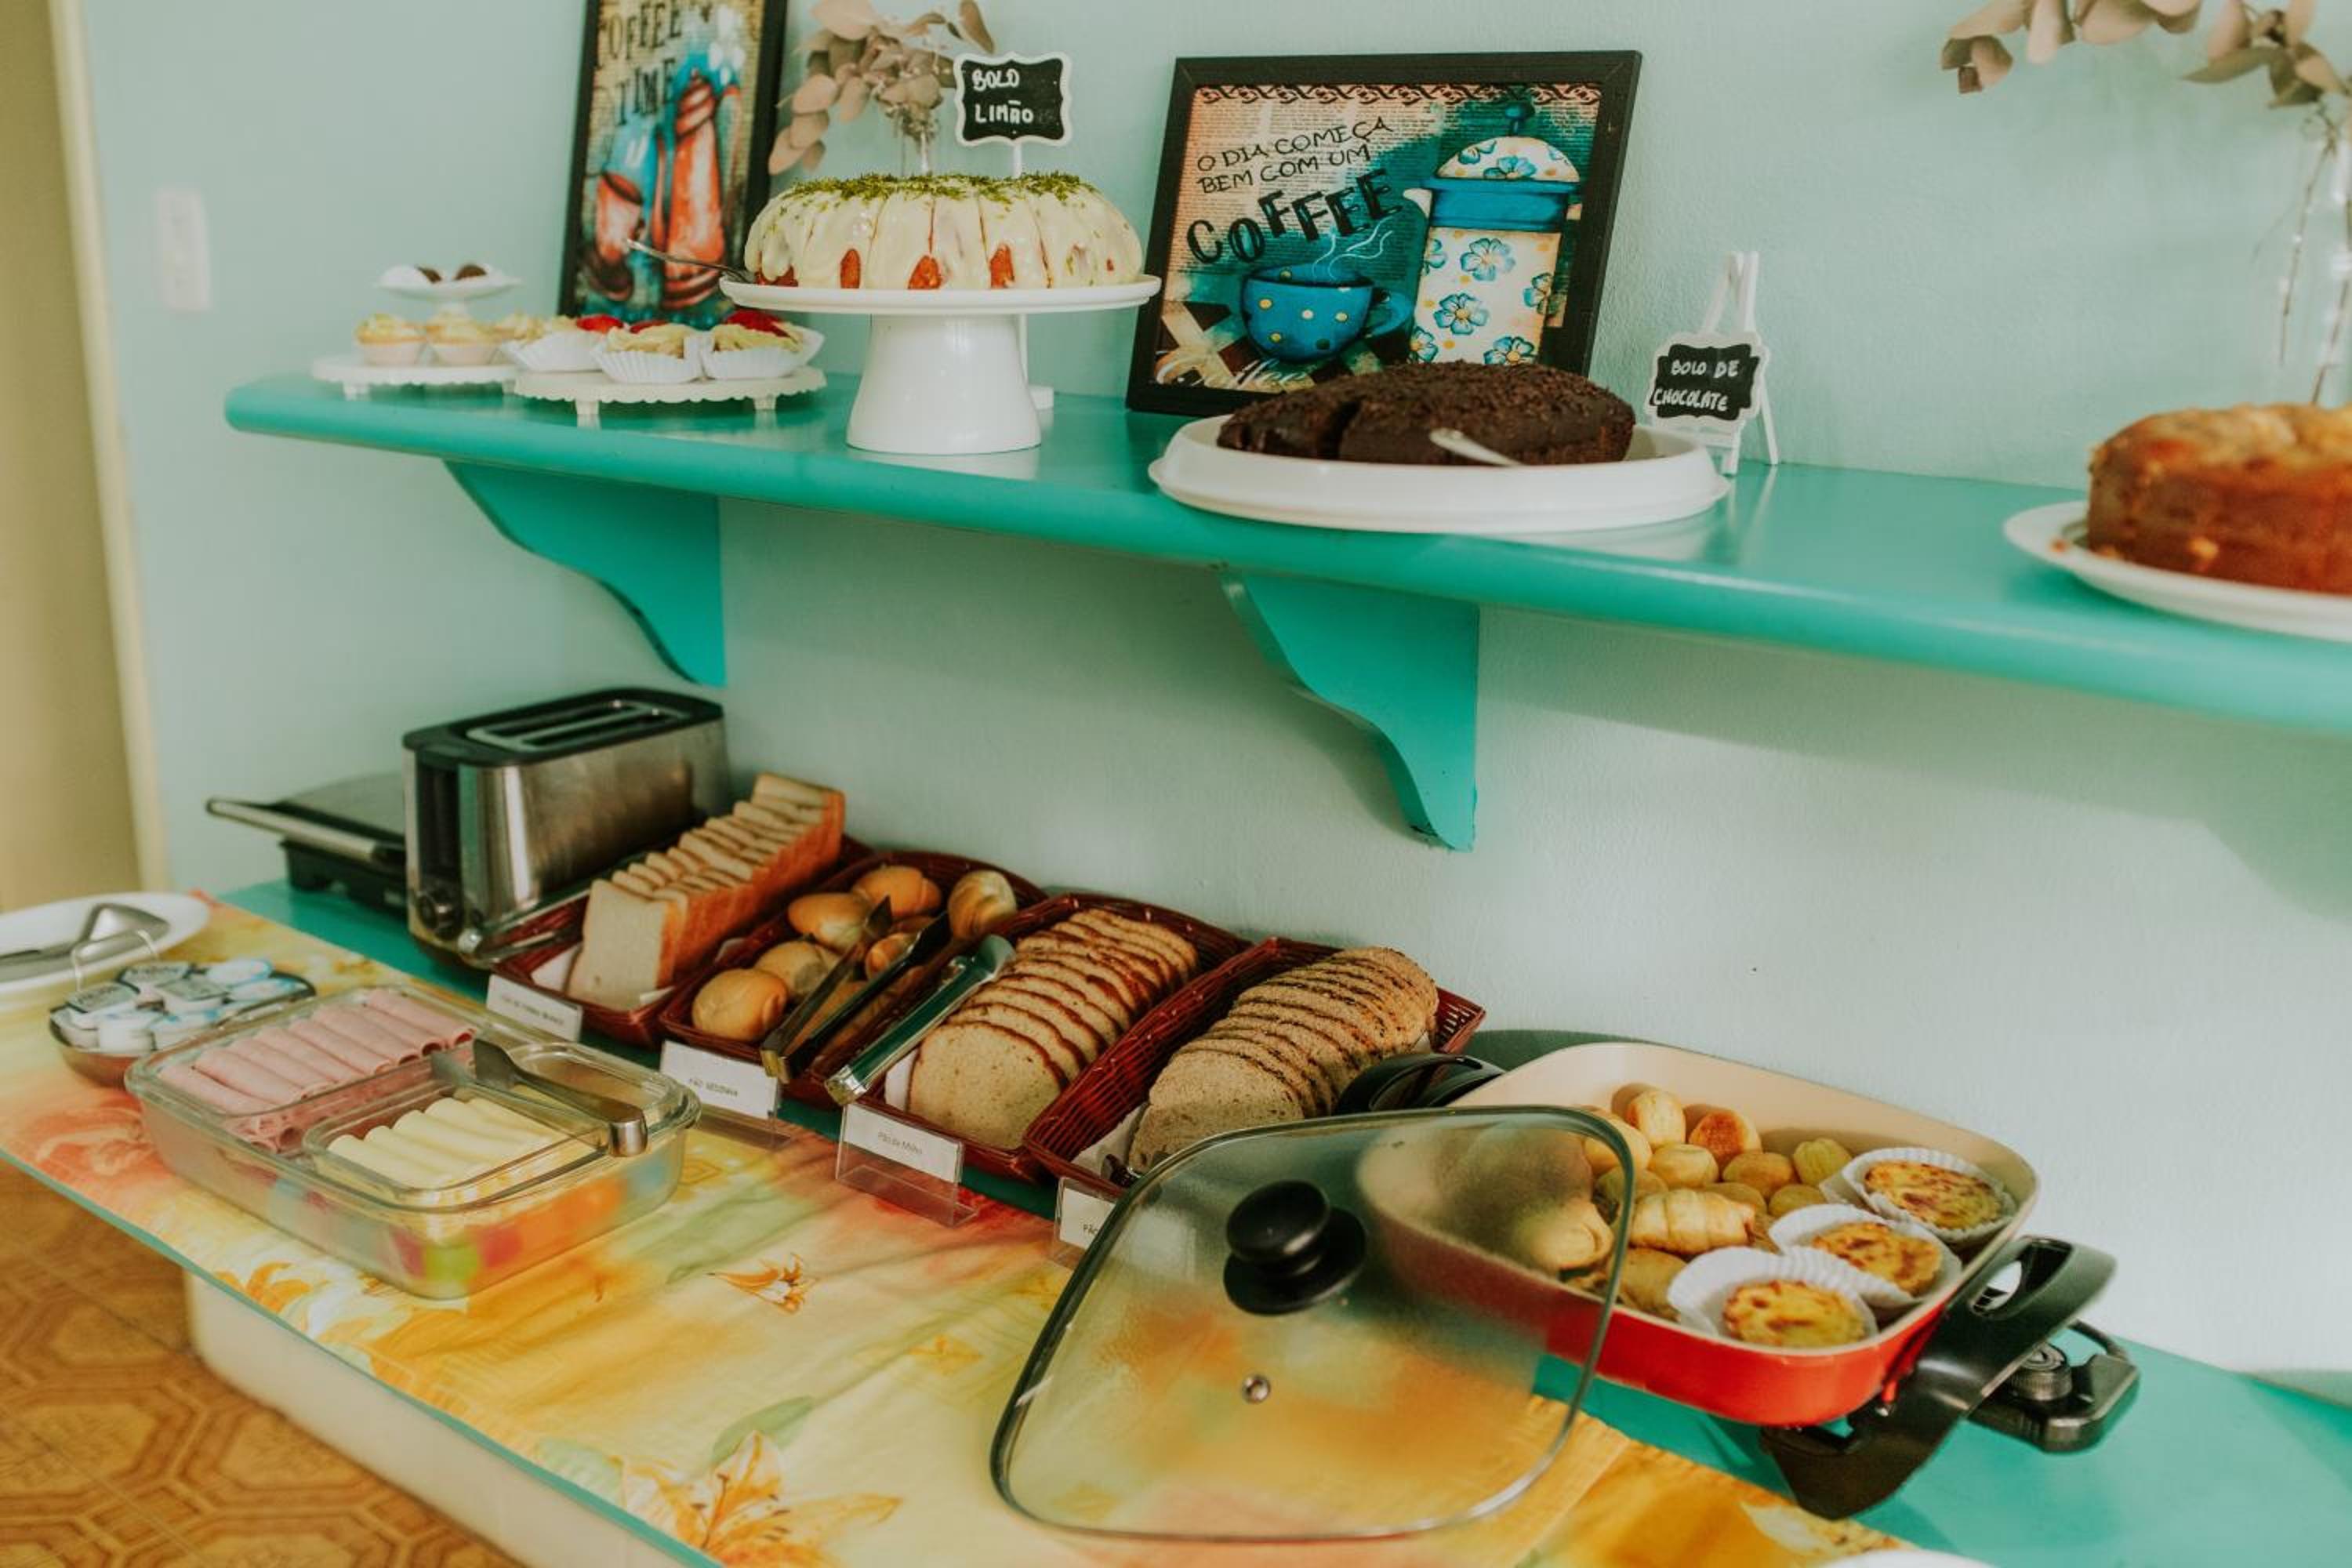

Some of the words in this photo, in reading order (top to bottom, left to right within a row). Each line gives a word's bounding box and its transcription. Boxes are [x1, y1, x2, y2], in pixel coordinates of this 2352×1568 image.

[615, 59, 676, 125] TIME
[971, 68, 1019, 91] BOLO
[975, 100, 1034, 124] LIMÃO
[1197, 155, 1216, 172] O
[1221, 144, 1269, 167] DIA
[1275, 116, 1395, 155] COMEÇA
[1196, 170, 1254, 194] BEM
[1260, 156, 1319, 182] COM
[1328, 143, 1371, 166] UM
[1186, 168, 1404, 264] COFFEE
[1671, 359, 1707, 376] BOLO
[1714, 360, 1740, 378] DE
[1653, 387, 1729, 412] CHOCOLATE
